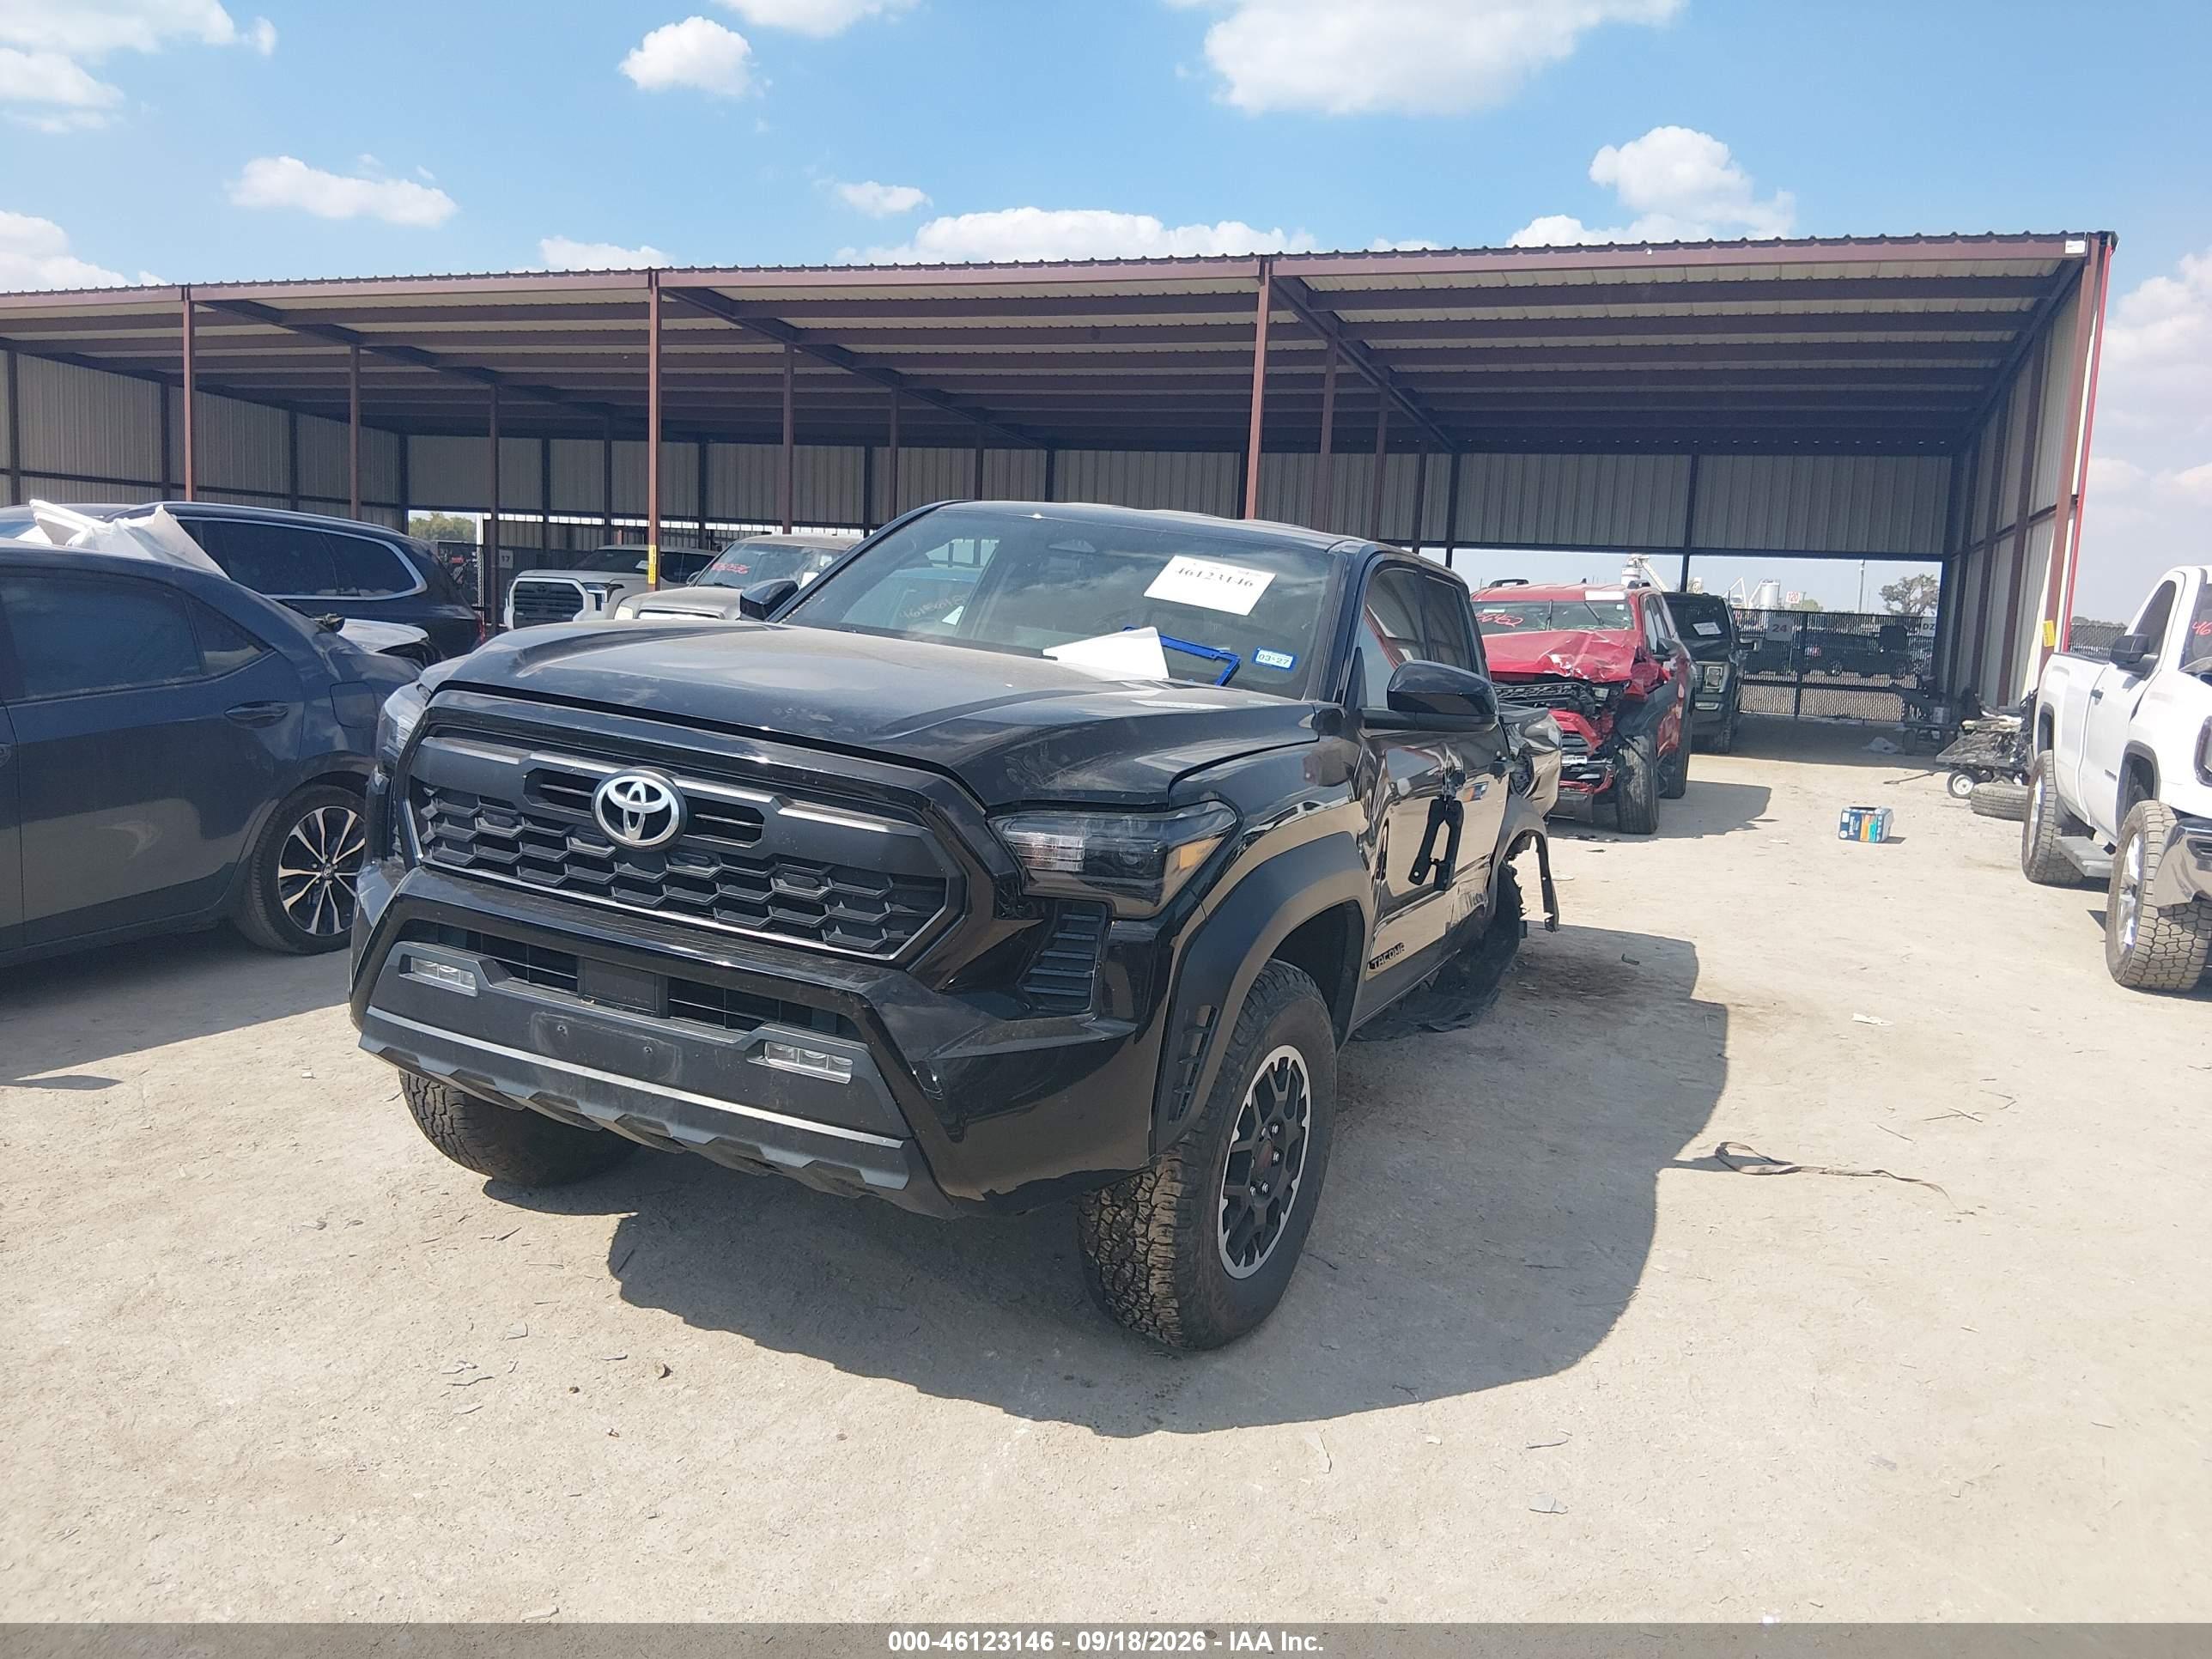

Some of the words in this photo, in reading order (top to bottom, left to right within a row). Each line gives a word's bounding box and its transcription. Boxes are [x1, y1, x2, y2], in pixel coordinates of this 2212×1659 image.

[1176, 568, 1254, 587] 46123146
[1771, 623, 1788, 633] 24
[1369, 942, 1405, 969] TACOMA
